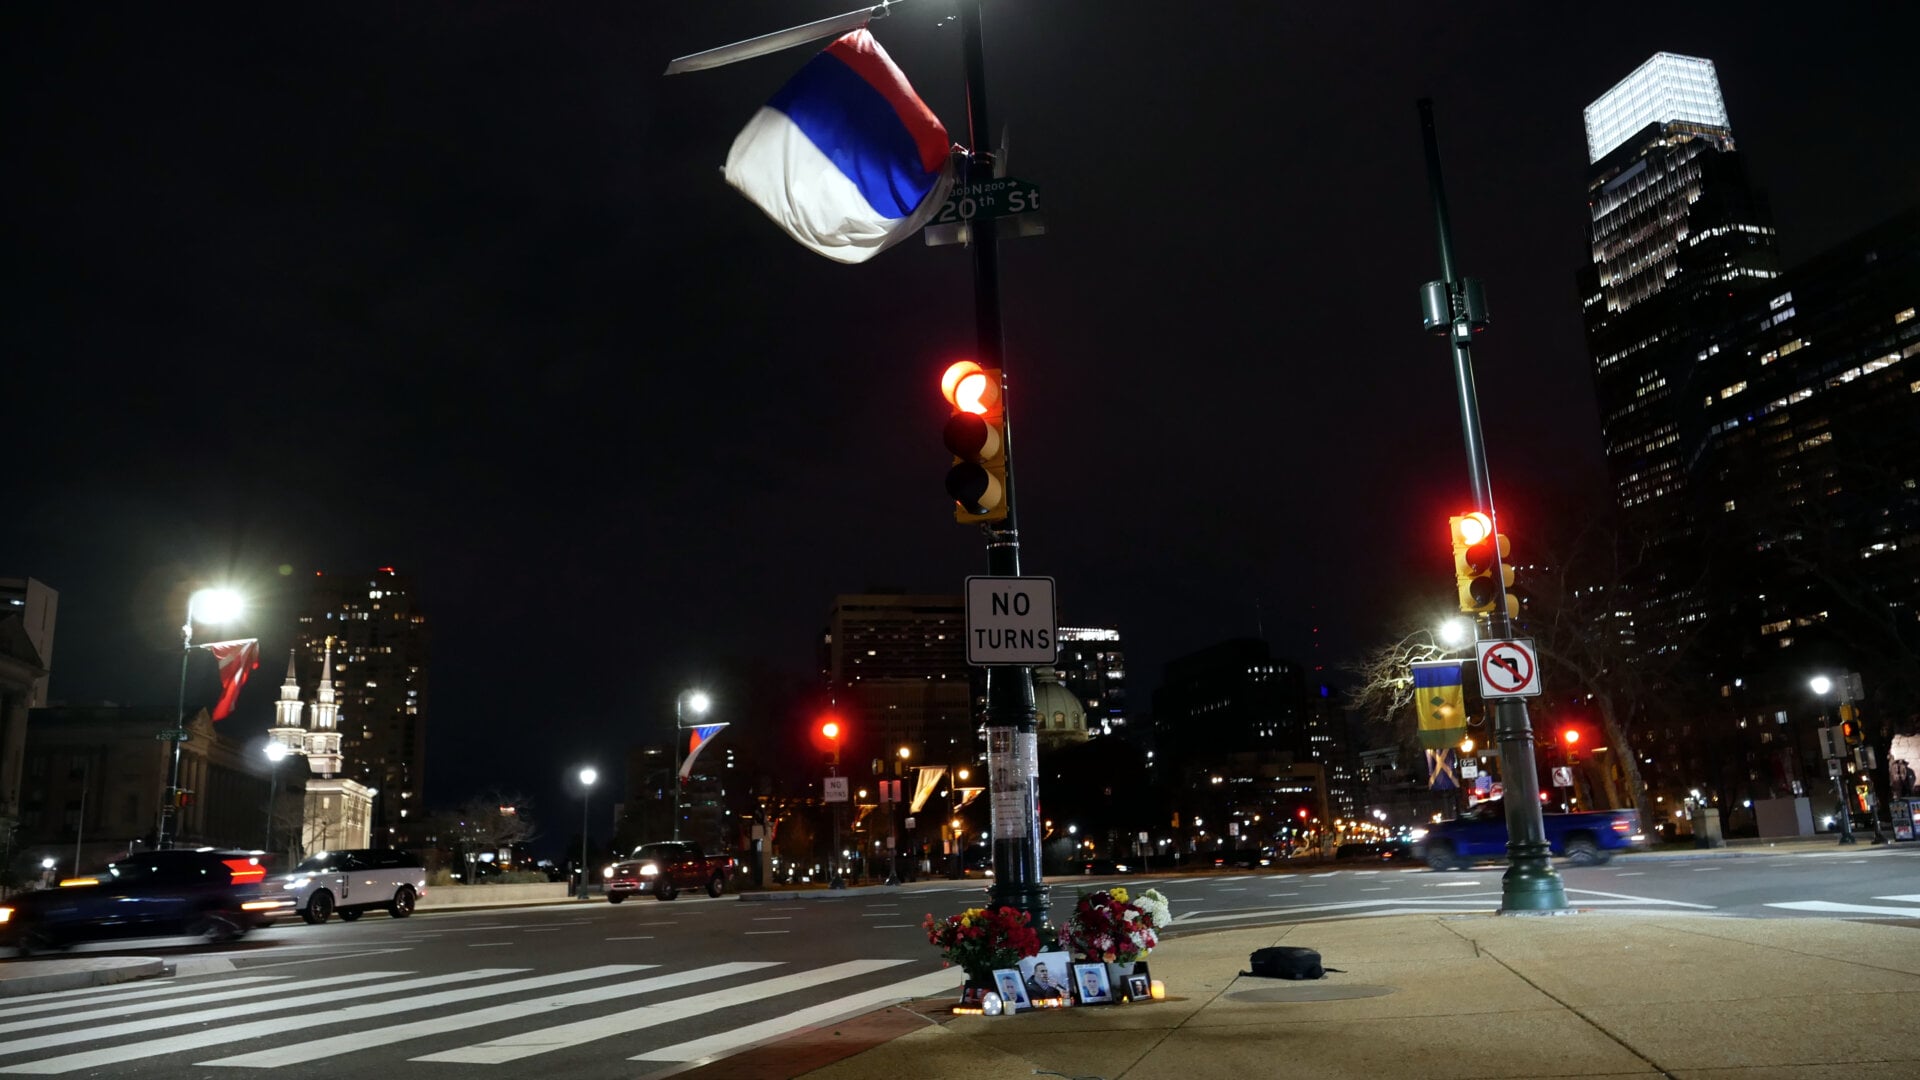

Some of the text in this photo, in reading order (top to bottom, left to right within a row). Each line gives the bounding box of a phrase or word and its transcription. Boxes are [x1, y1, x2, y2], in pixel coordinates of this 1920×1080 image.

[972, 184, 982, 195] N
[984, 182, 1005, 192] 200
[939, 189, 1040, 222] 20th St
[992, 592, 1030, 616] NO
[974, 629, 1050, 649] TURNS
[830, 781, 841, 789] NO
